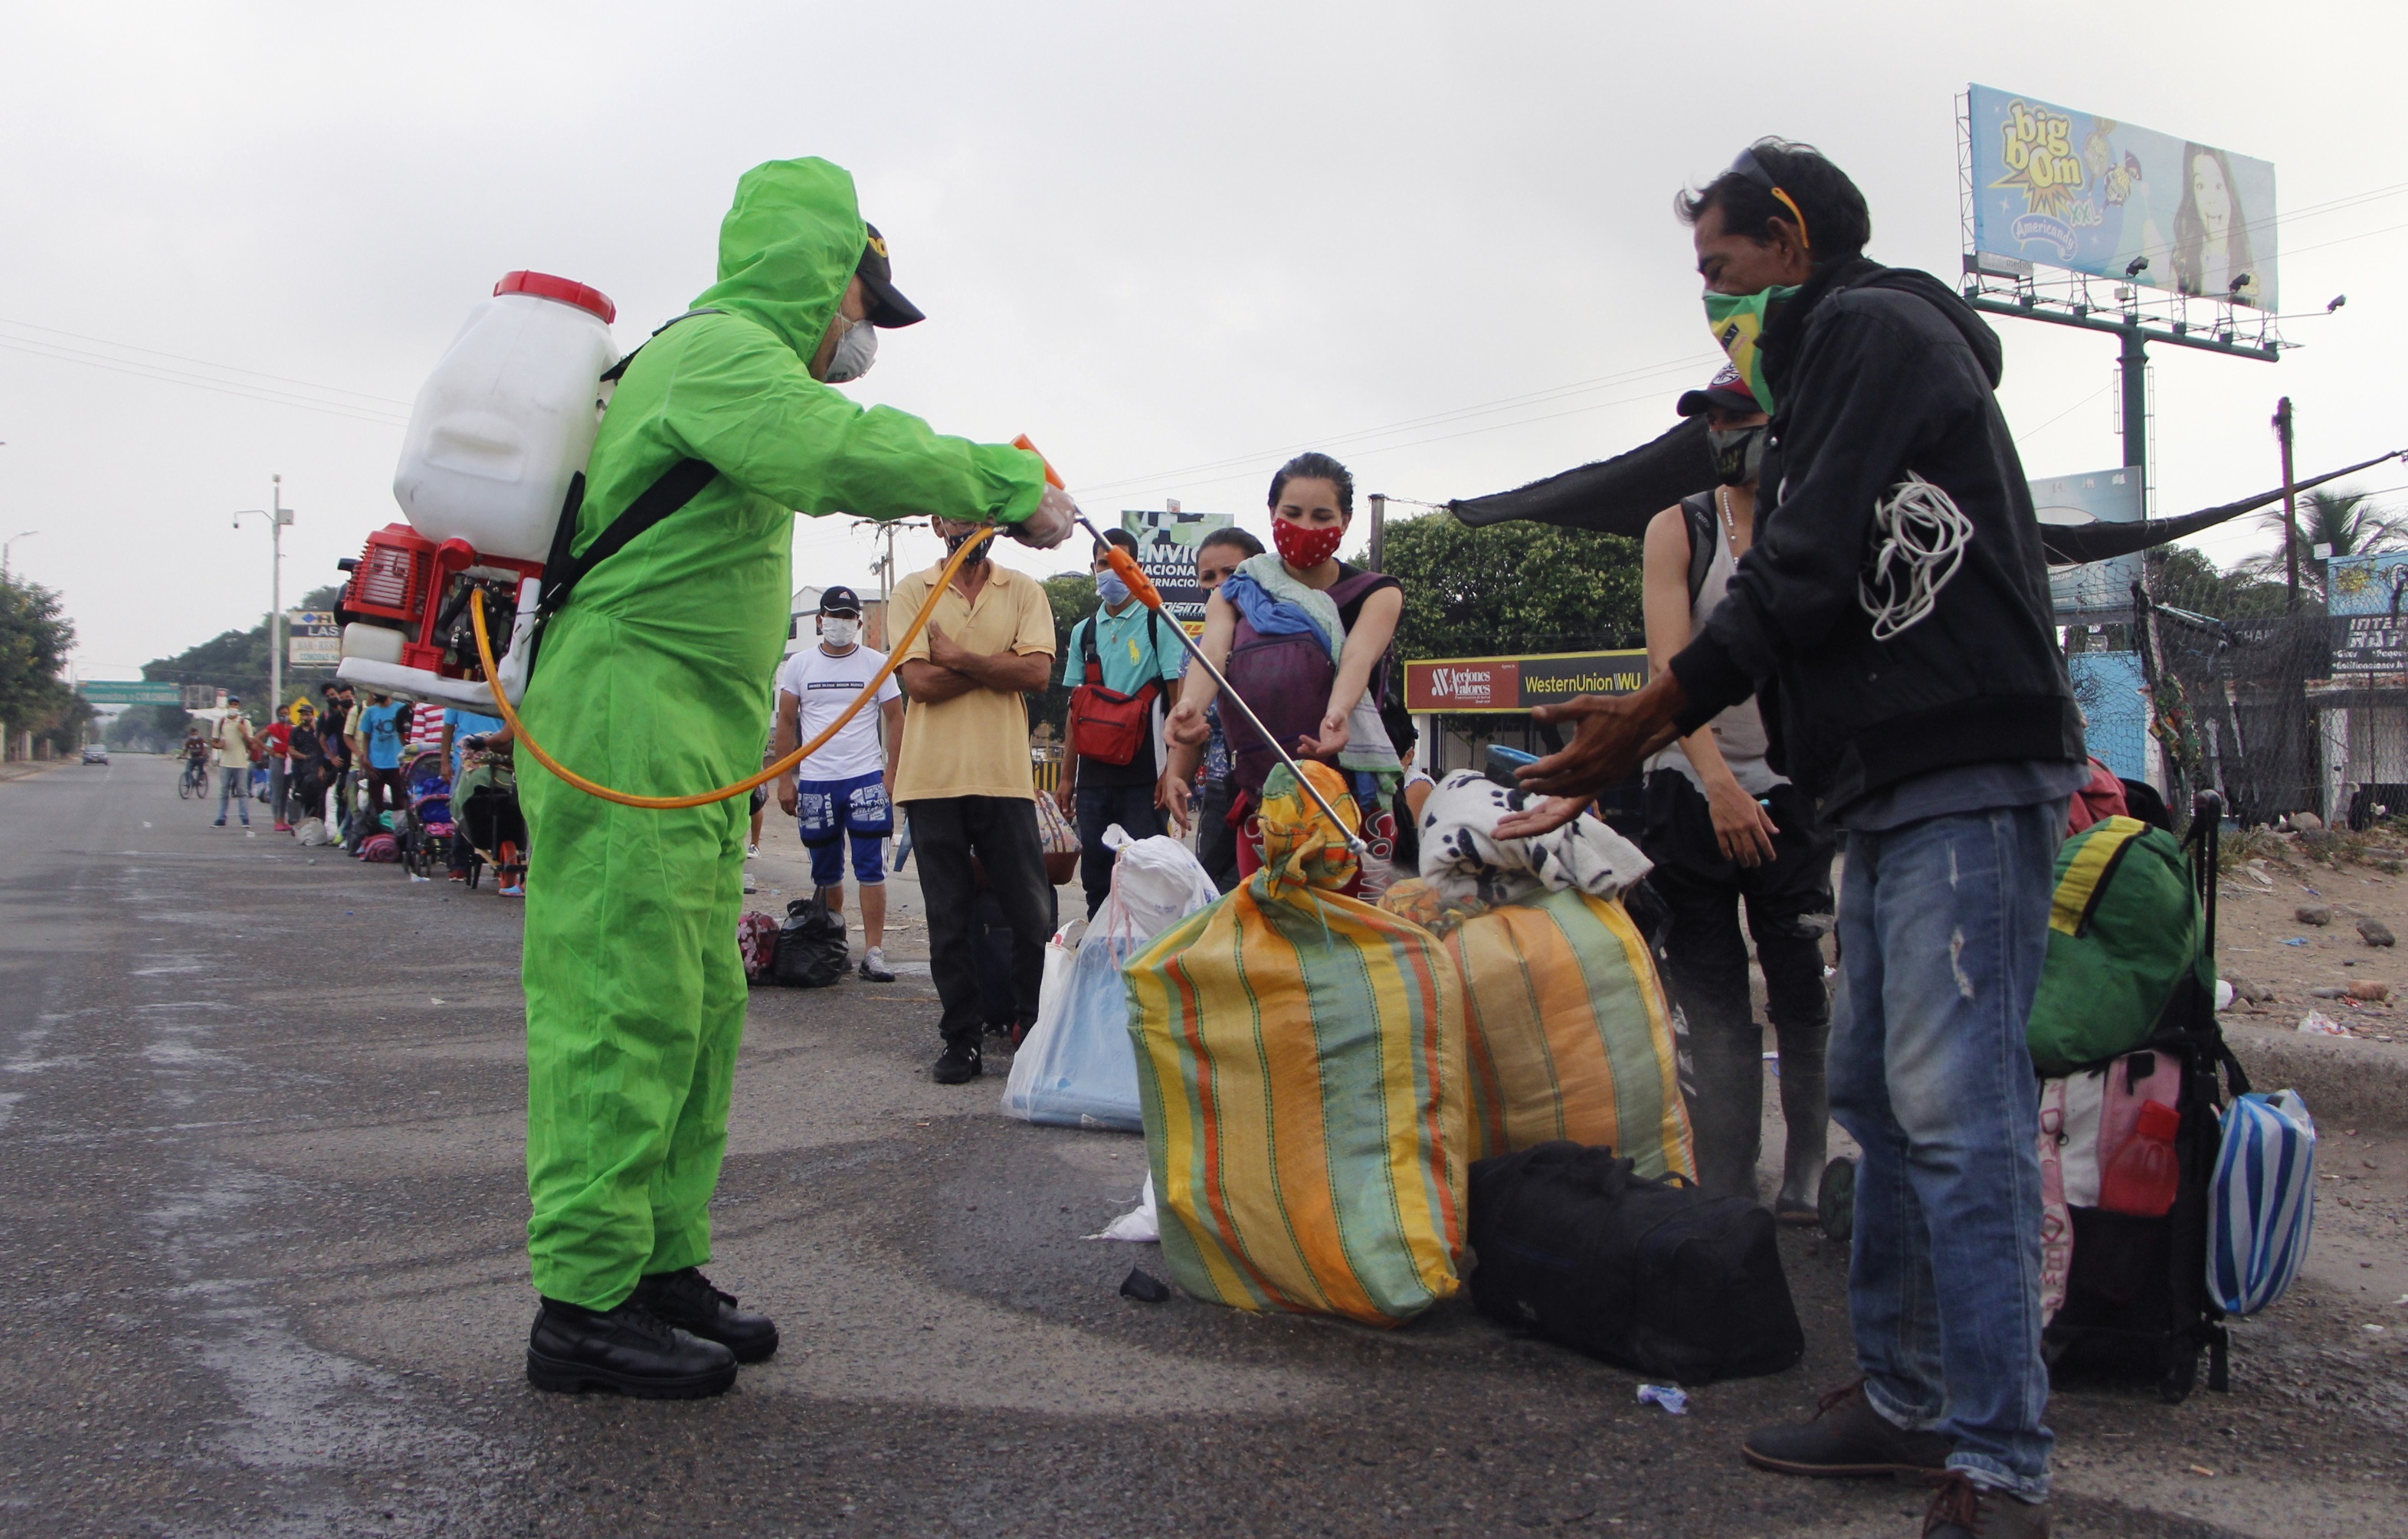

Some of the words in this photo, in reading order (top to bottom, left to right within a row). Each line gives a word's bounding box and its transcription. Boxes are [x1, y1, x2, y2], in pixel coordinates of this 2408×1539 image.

[2010, 103, 2069, 157] big
[2068, 198, 2102, 228] XXL
[2016, 219, 2075, 250] Americandy
[1140, 565, 1197, 577] ACIONA
[308, 626, 339, 637] LAS
[1450, 668, 1491, 683] Acciones
[824, 792, 834, 827] YORK
